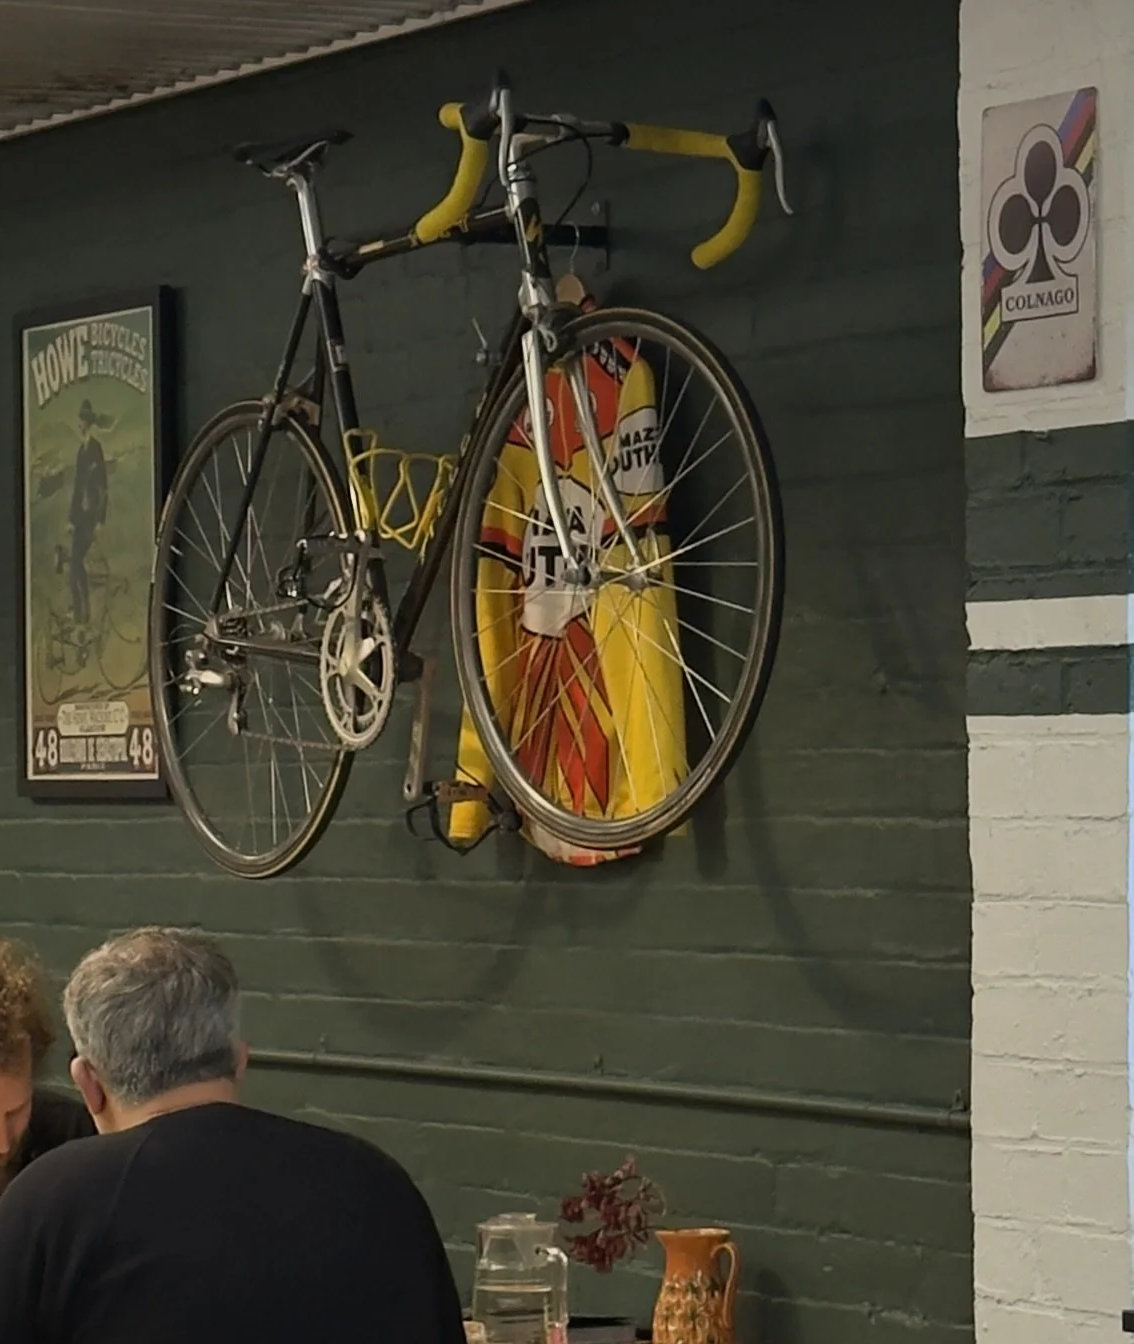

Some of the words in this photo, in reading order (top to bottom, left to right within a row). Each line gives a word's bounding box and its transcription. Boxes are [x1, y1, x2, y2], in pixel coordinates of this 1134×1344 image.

[1006, 287, 1074, 312] COLNAGO
[31, 324, 88, 407] HOWE
[90, 321, 147, 361] BICYCLES
[90, 349, 148, 393] TRICYCLES
[620, 426, 660, 448] MAZ
[35, 729, 58, 767] 48
[129, 727, 153, 766] 48
